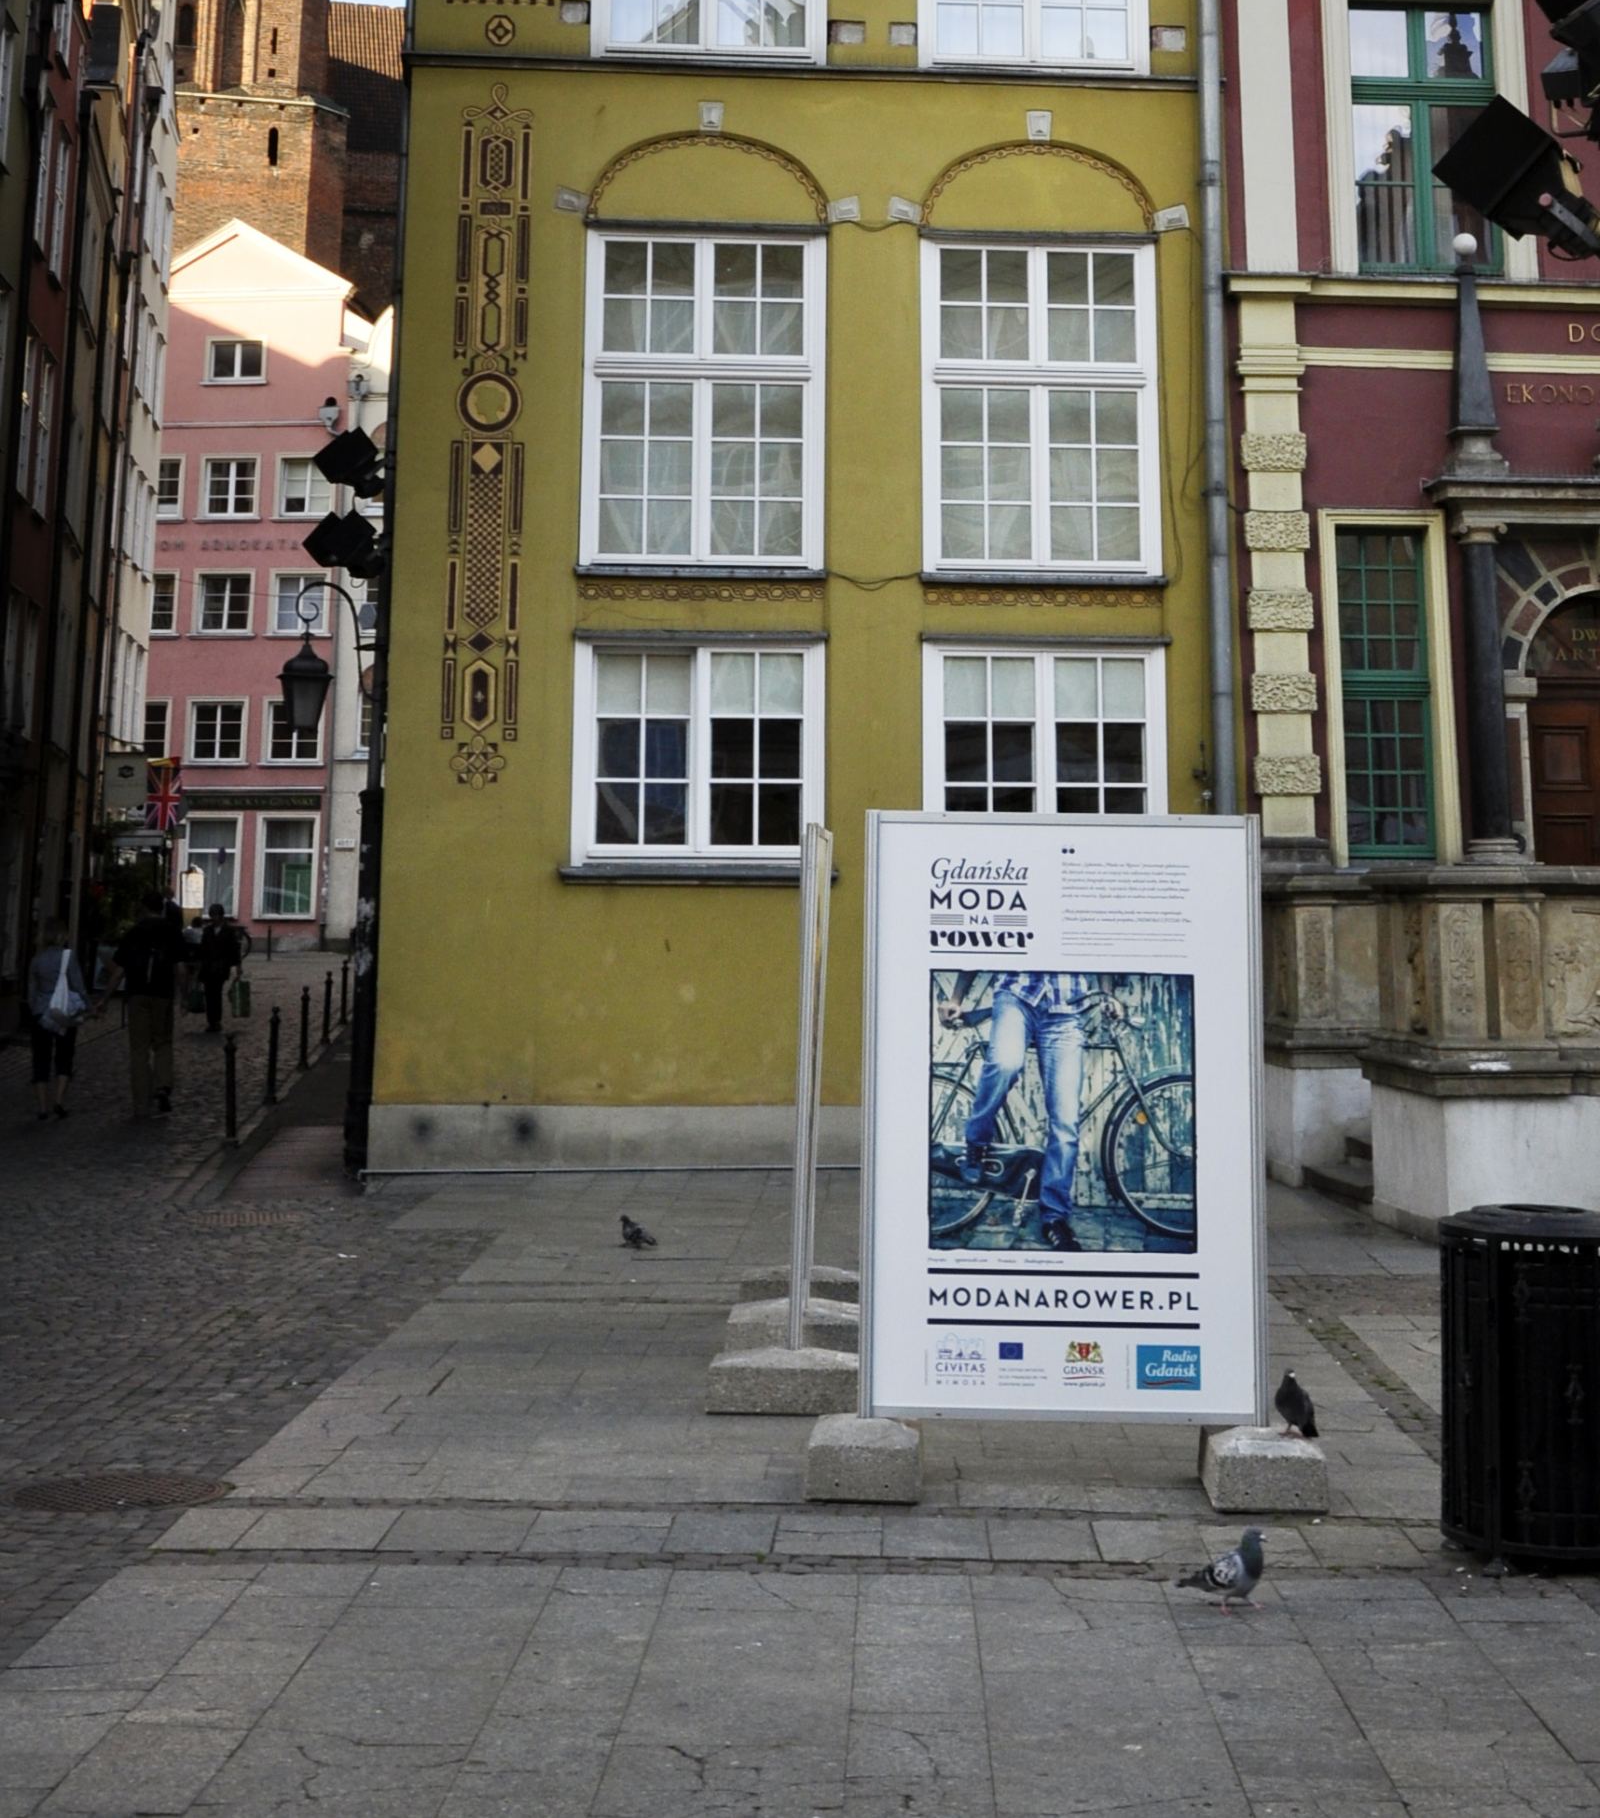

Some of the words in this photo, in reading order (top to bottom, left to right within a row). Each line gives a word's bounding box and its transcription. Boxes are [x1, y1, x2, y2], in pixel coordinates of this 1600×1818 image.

[158, 539, 186, 552] OM
[930, 857, 1029, 889] Gdańska
[930, 888, 1027, 911] MODA
[969, 915, 989, 925] NA
[929, 930, 1034, 948] rower
[929, 1287, 1199, 1311] MODANAROWER.PL
[1162, 1349, 1198, 1362] Radio
[1145, 1362, 1197, 1377] Gdańsk
